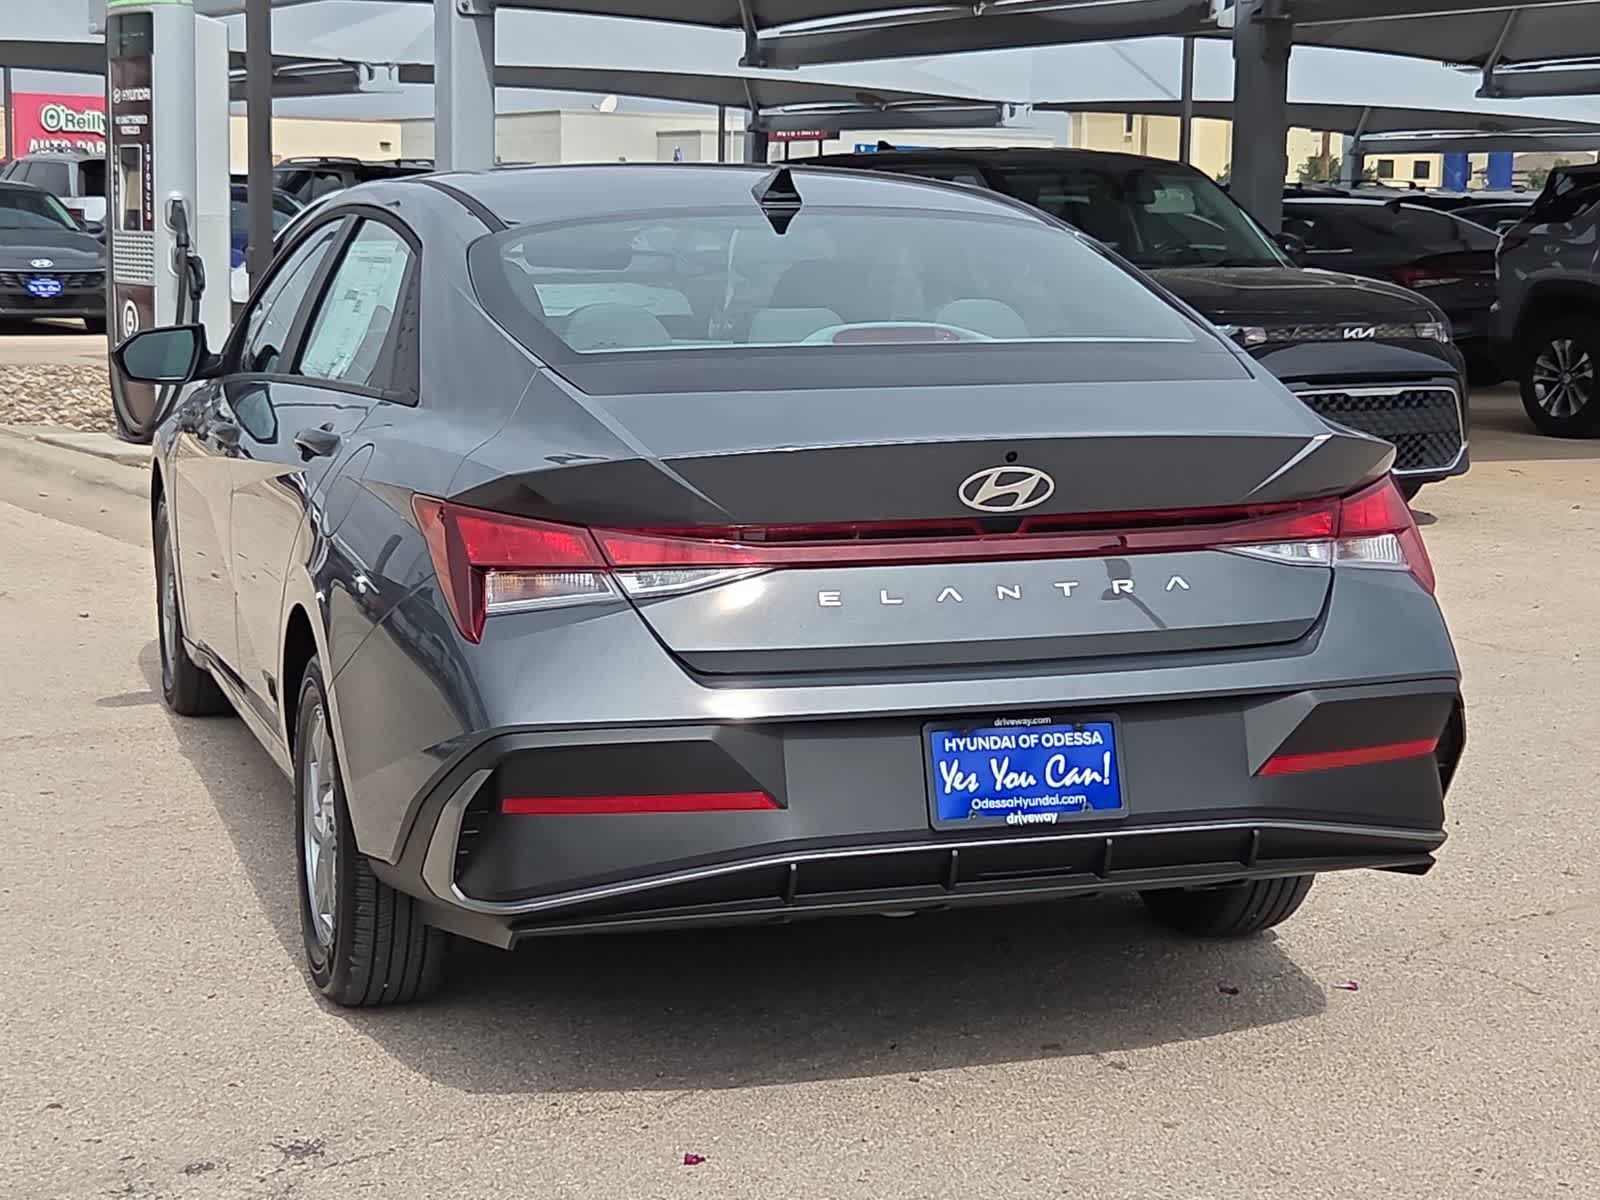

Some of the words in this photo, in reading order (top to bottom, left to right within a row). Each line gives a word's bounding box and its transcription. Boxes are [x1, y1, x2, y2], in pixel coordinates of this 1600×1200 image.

[818, 575, 1190, 606] ELANTRA
[993, 717, 1051, 728] driveway.com
[944, 735, 1016, 752] HYUNDAI
[1018, 734, 1039, 748] OF
[1041, 731, 1103, 748] ODESSA
[939, 759, 980, 794] Yes
[990, 756, 1037, 791] You
[1045, 751, 1111, 788] Can!
[971, 794, 1087, 811] OdessaHyundai.com
[1006, 810, 1058, 826] driveway
